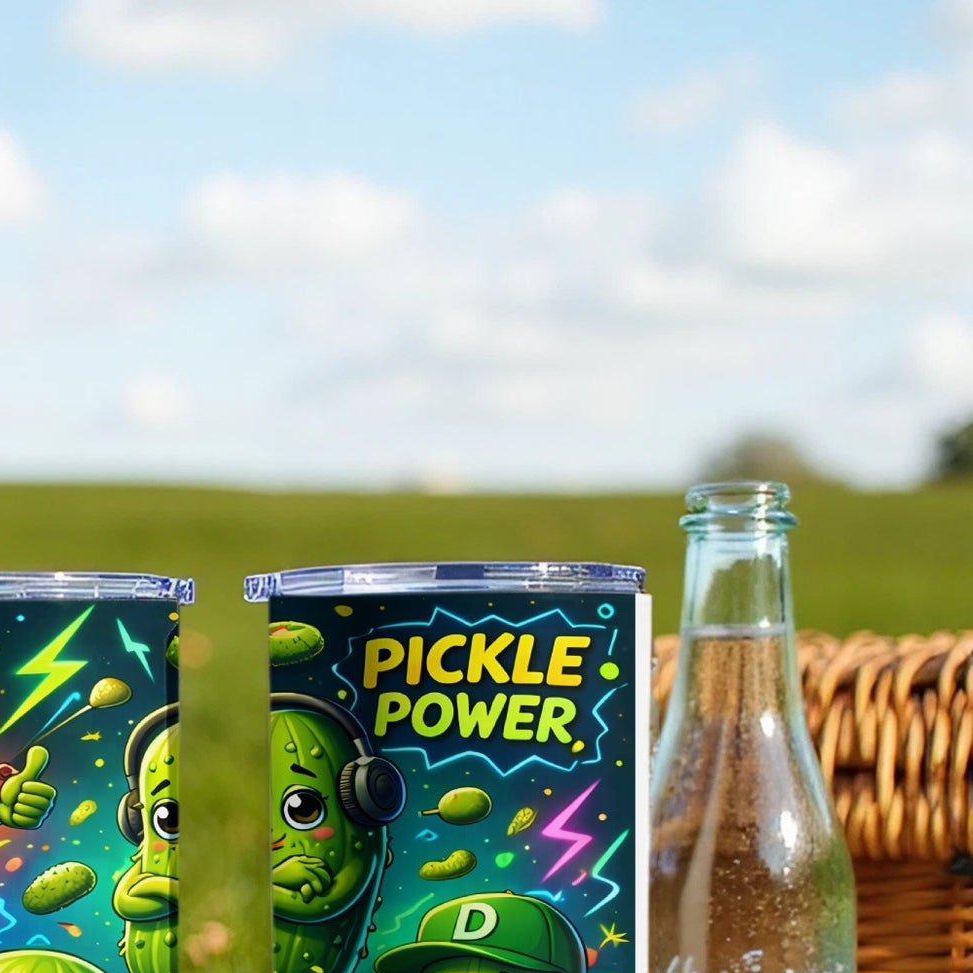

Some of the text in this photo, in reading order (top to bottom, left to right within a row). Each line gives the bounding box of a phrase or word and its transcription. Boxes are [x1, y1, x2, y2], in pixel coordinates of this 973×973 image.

[363, 632, 591, 689] PICKLE
[374, 692, 577, 744] POWER
[452, 902, 498, 941] D
